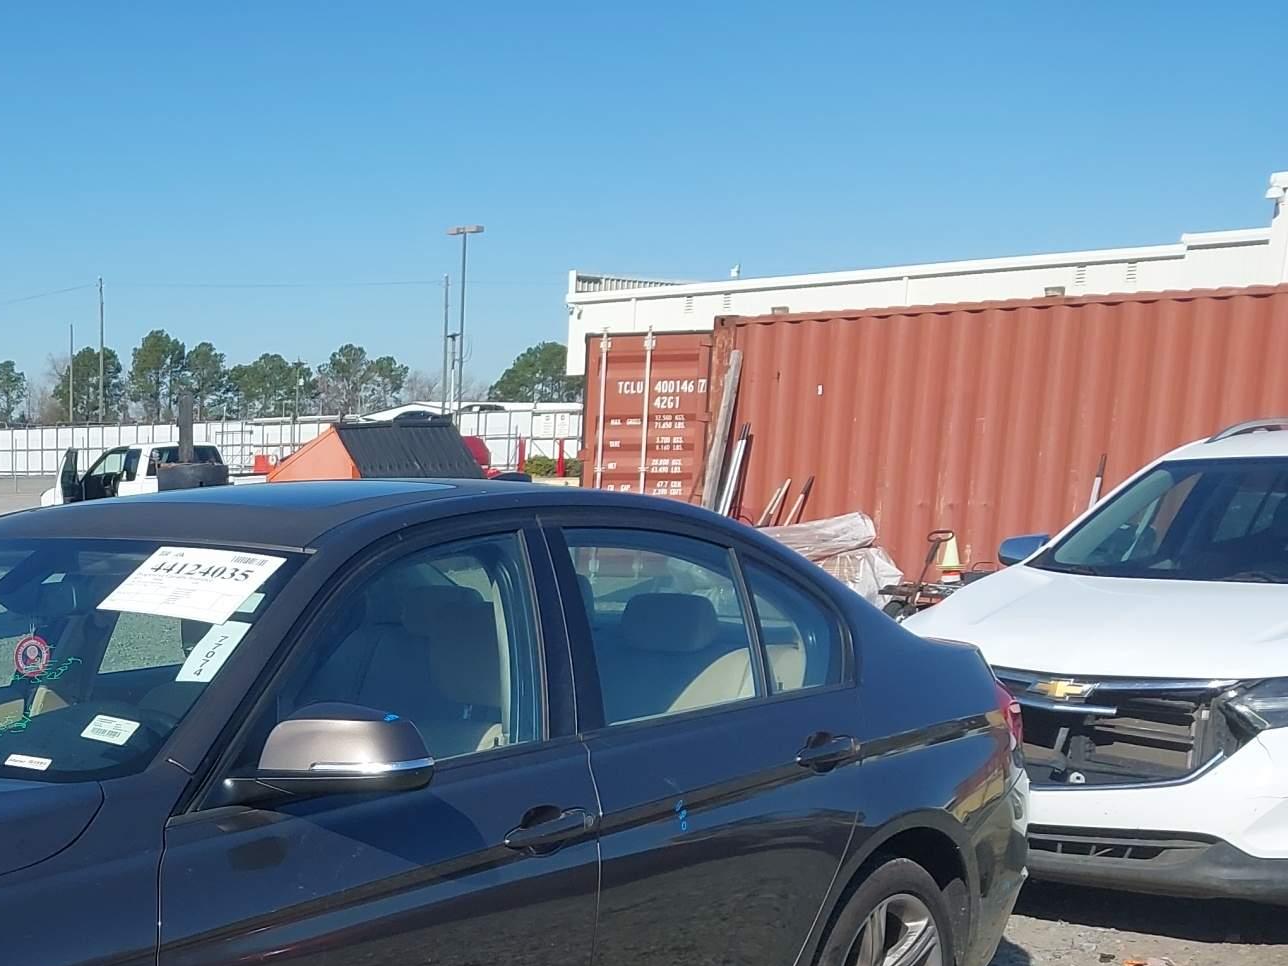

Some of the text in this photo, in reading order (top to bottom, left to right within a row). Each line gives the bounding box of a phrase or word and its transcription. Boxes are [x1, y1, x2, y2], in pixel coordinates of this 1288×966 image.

[618, 381, 644, 395] TCLU
[654, 380, 694, 393] 400146
[150, 561, 254, 582] 44124035
[193, 635, 229, 677] 77074
